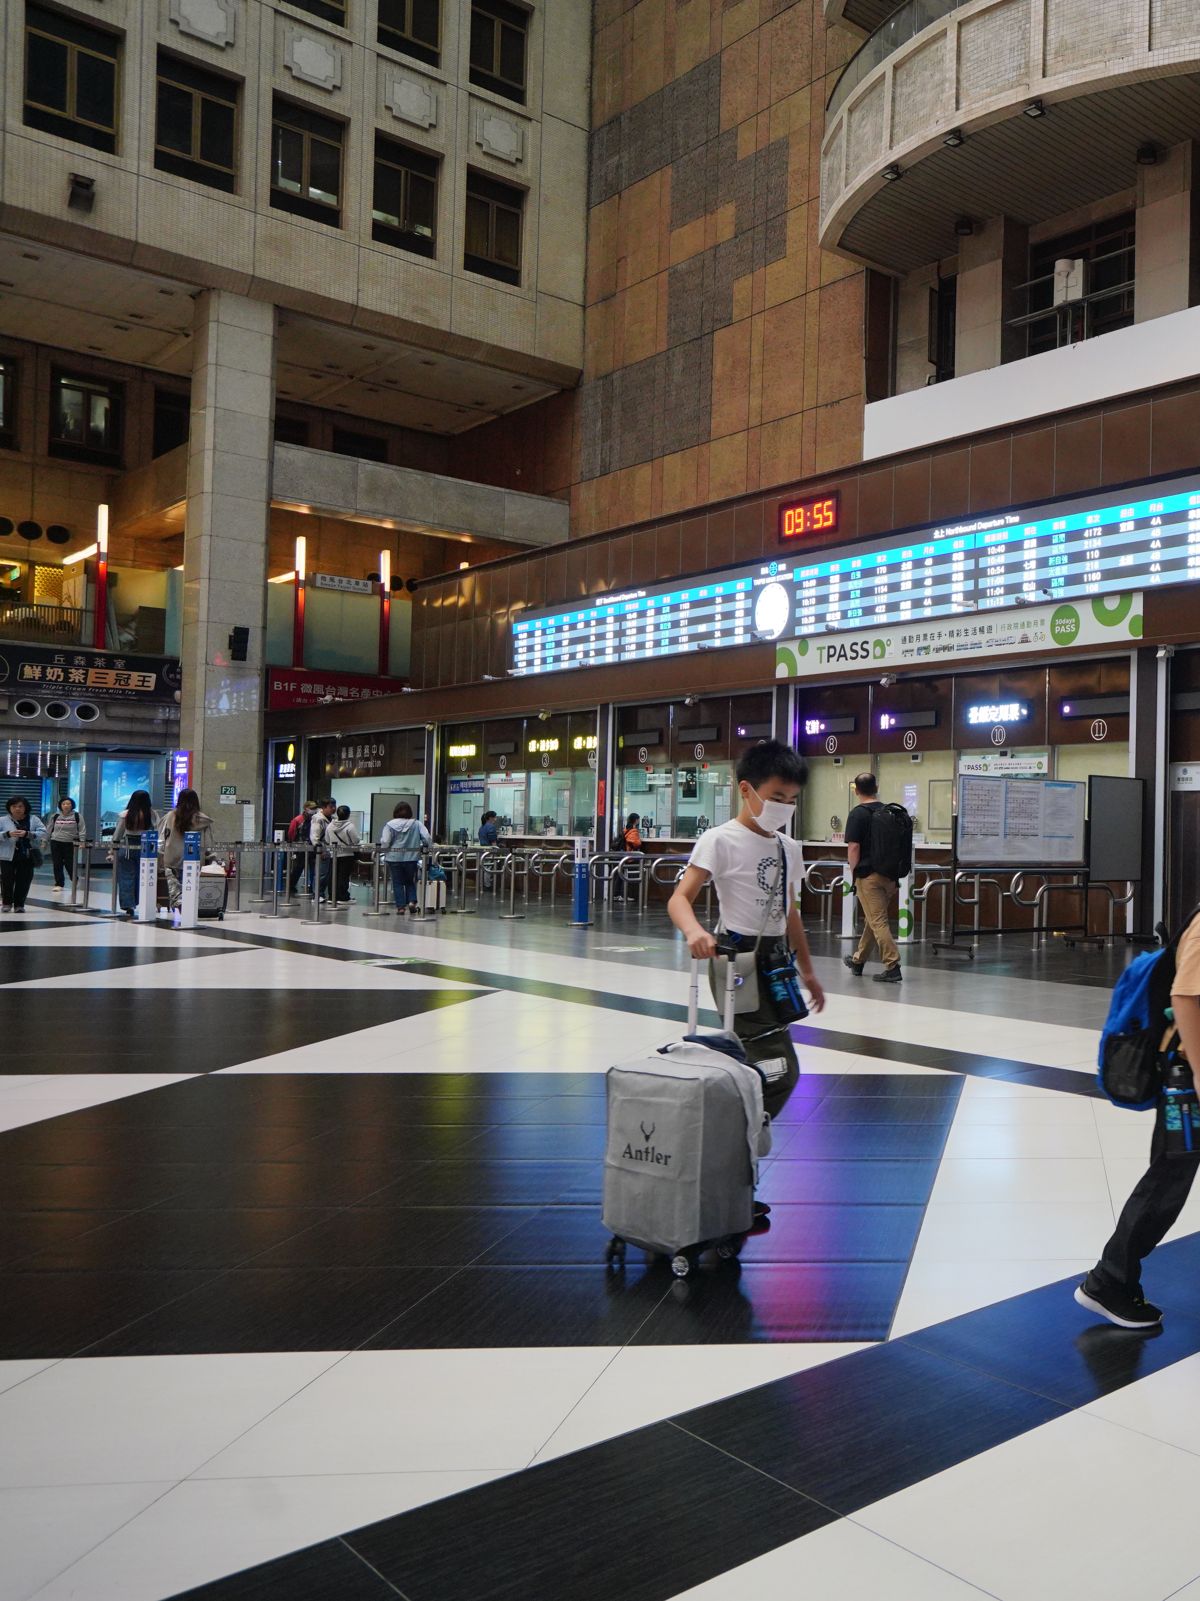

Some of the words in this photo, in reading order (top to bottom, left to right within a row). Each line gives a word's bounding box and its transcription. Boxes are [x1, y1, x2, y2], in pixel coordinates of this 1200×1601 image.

[784, 501, 833, 535] 09:55
[1150, 517, 1161, 526] 4A
[946, 524, 976, 537] Northbound
[977, 518, 1004, 531] Departure
[1005, 515, 1020, 524] Time
[1150, 540, 1161, 549] 4A
[1150, 563, 1161, 572] 4A
[1055, 624, 1076, 634] PASS
[816, 640, 869, 664] TPASS
[53, 654, 127, 670] 丘森茶室
[23, 665, 152, 688] 鮮奶茶三冠王
[273, 681, 297, 692] B1F
[222, 786, 235, 795] F28
[622, 1142, 672, 1166] Antler
